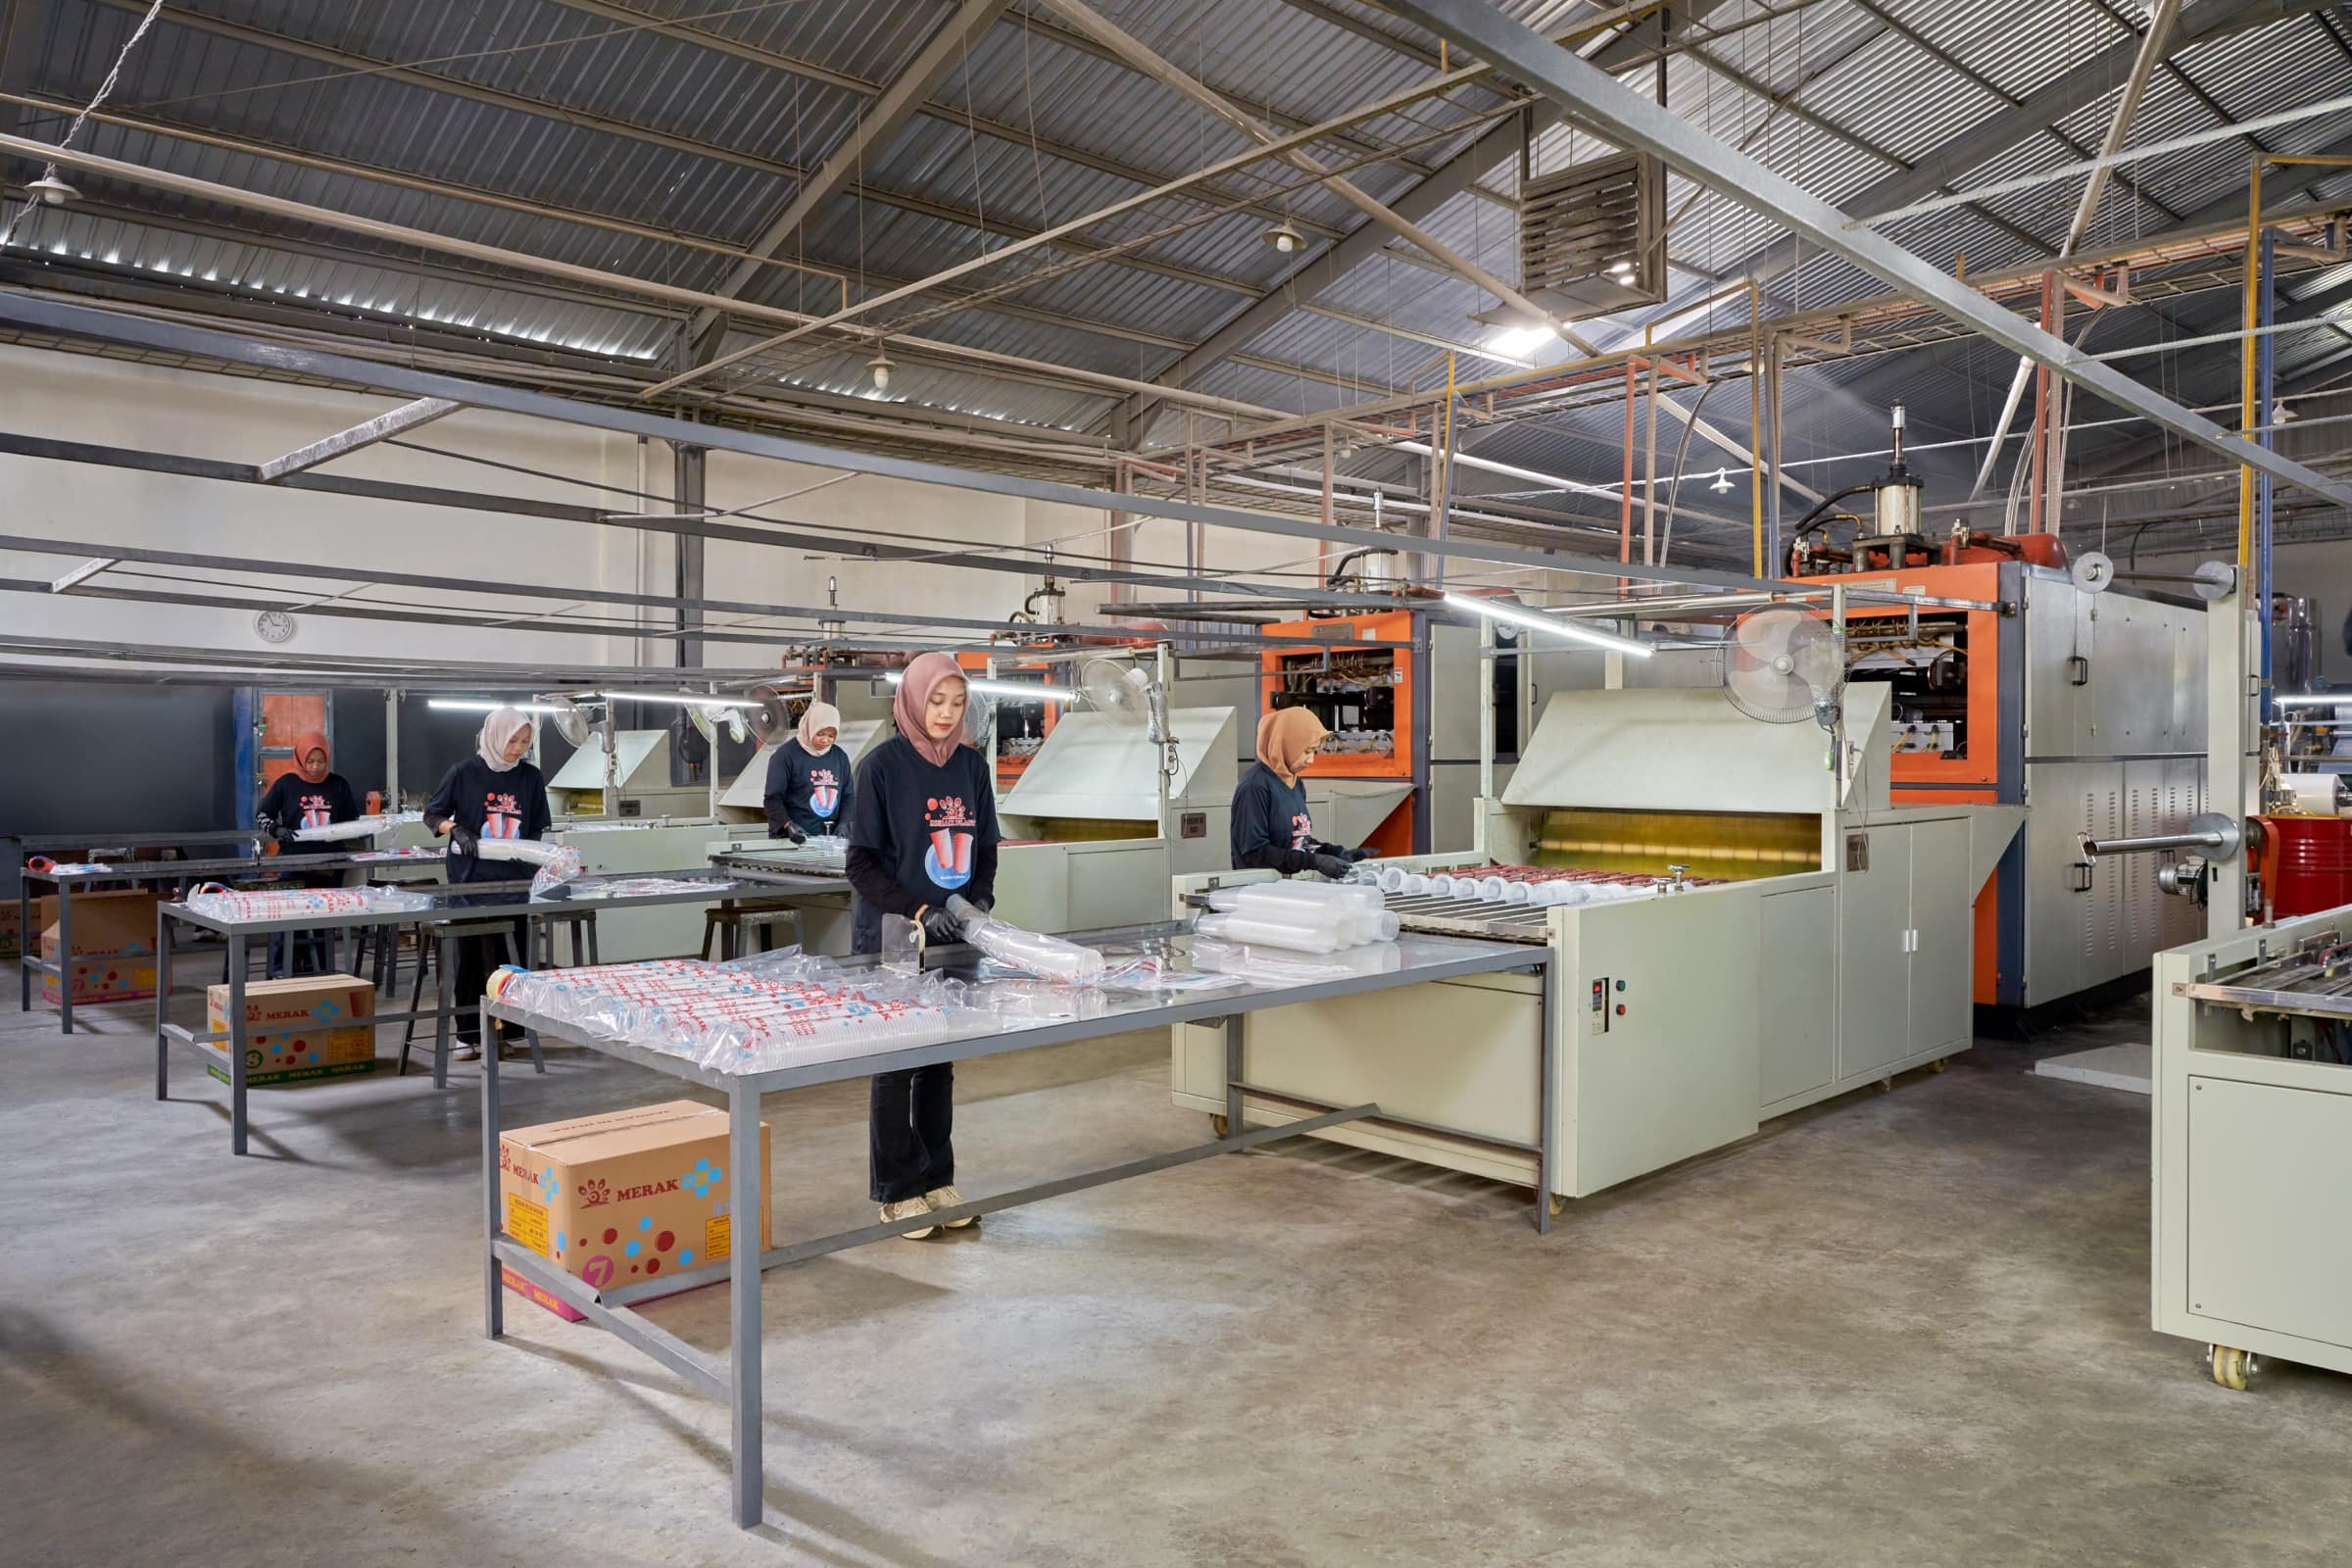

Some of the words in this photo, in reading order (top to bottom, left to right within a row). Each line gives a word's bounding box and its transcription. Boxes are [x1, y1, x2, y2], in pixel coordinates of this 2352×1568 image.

[266, 1009, 310, 1020] MERAK
[513, 1163, 540, 1185] MERAK
[616, 1178, 679, 1202] MERAK
[588, 1259, 609, 1287] 7
[533, 1289, 560, 1310] MERAK
